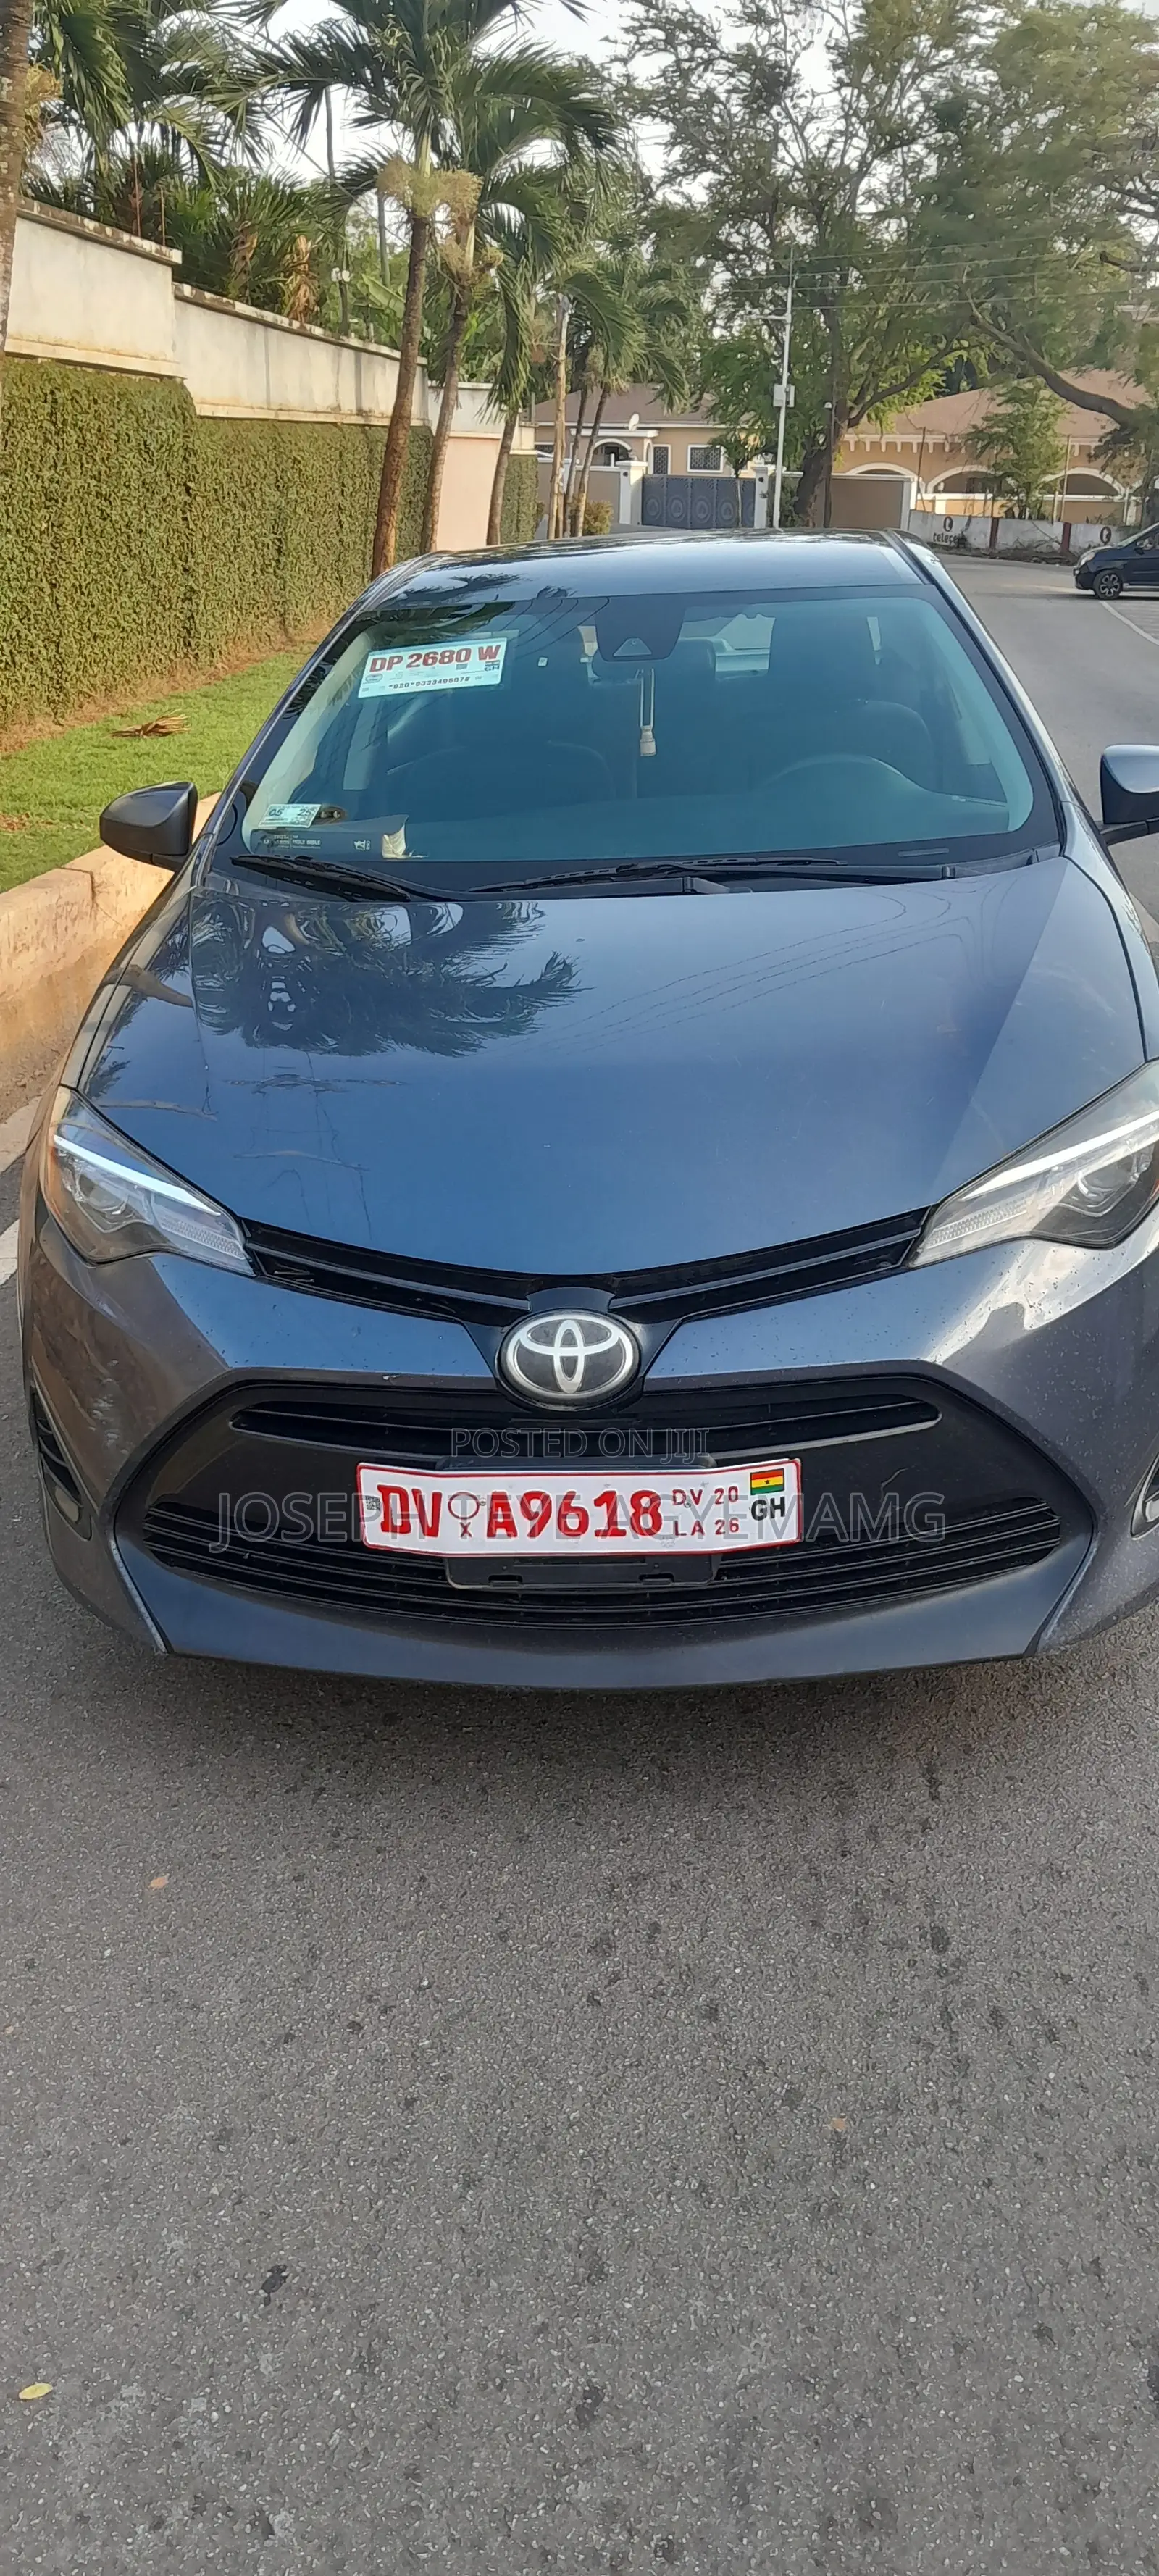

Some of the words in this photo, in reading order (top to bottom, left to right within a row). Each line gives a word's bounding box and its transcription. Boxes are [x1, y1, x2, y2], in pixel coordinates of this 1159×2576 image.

[369, 656, 403, 672] DP
[406, 648, 472, 669] 2680
[478, 645, 501, 661] W
[714, 1486, 738, 1505] 20
[377, 1484, 443, 1537] DV
[486, 1490, 664, 1538] A9618
[750, 1497, 785, 1521] GH
[714, 1518, 740, 1535] 26
